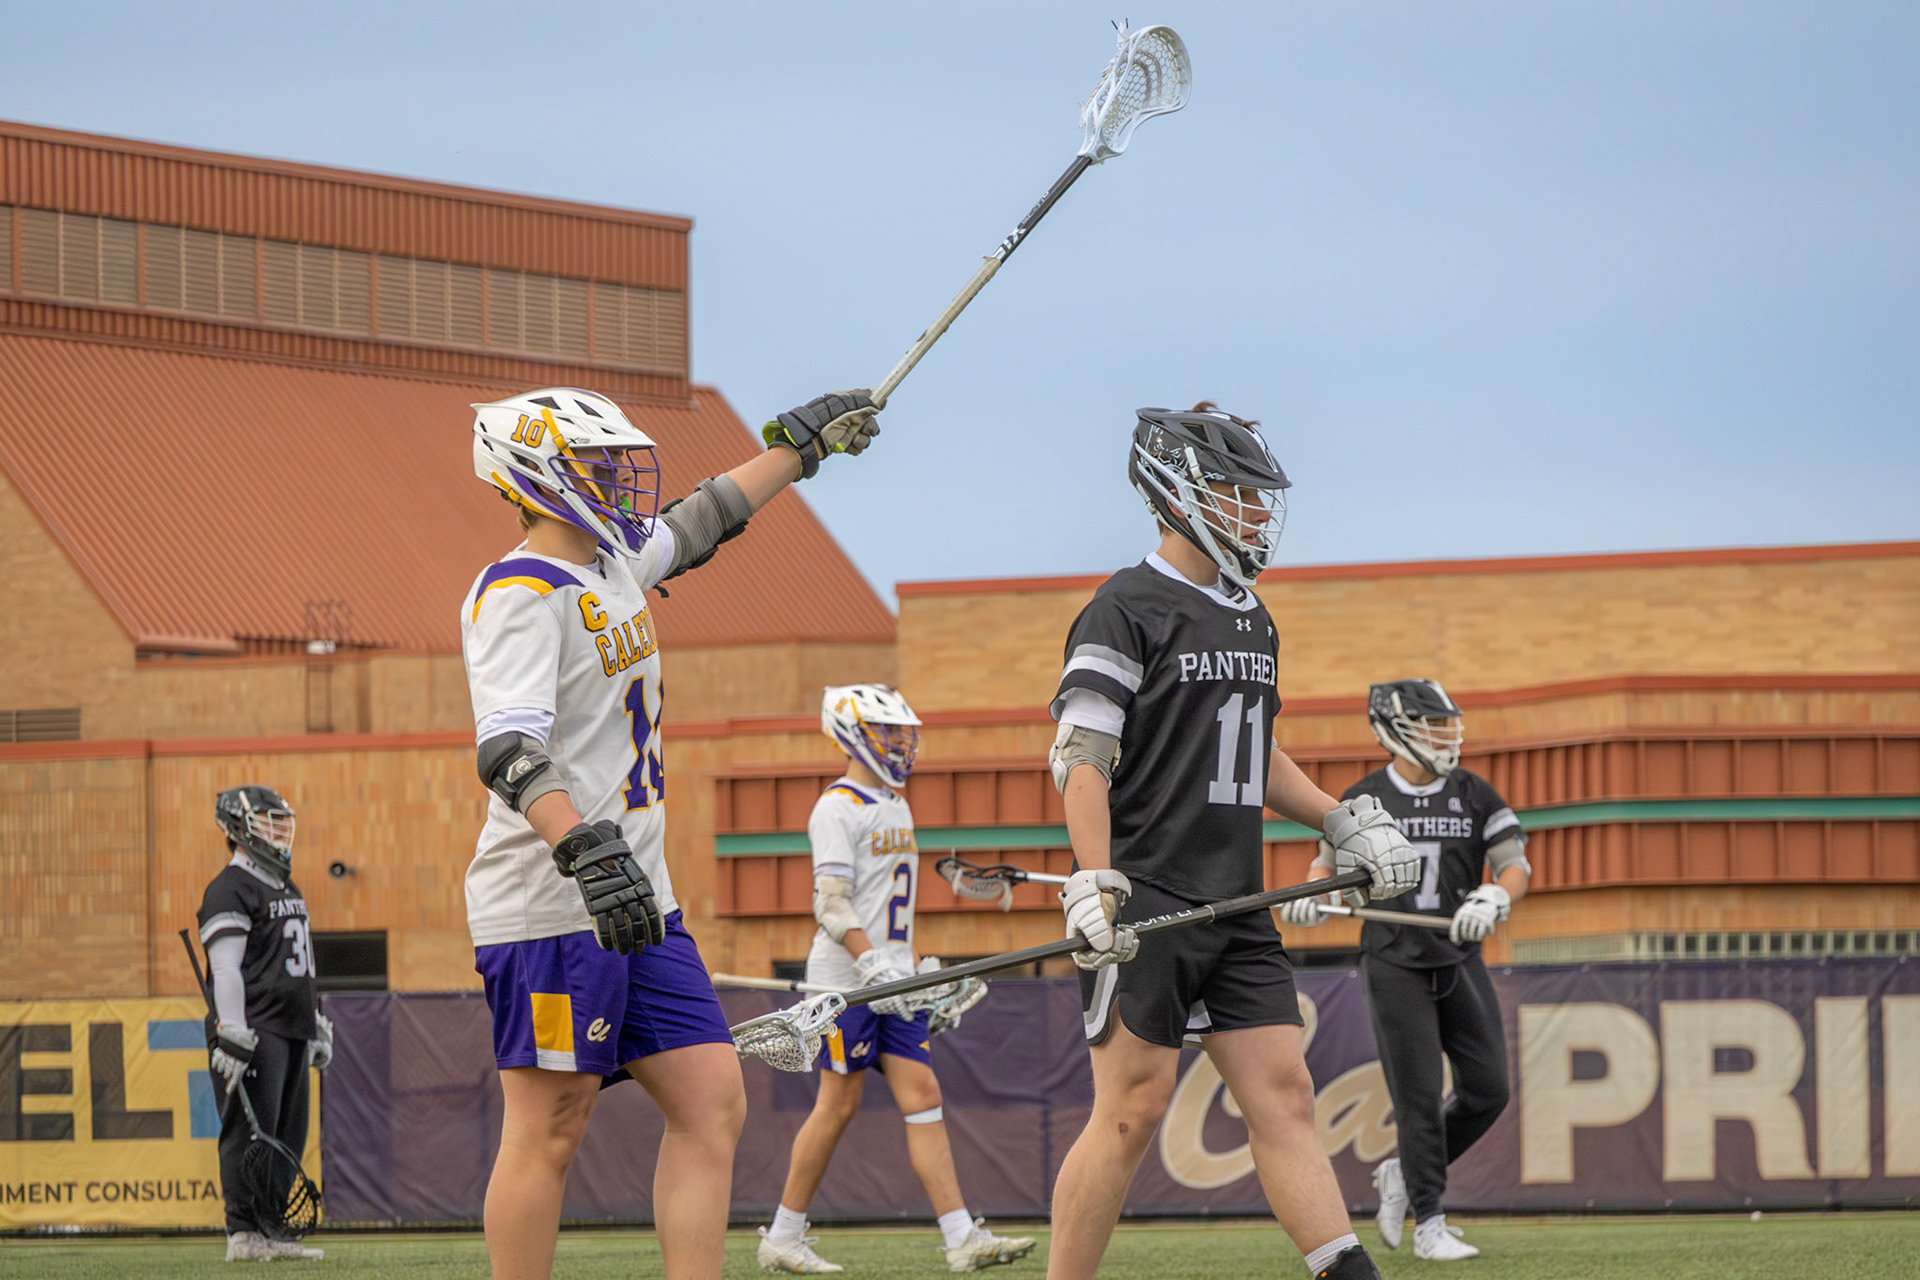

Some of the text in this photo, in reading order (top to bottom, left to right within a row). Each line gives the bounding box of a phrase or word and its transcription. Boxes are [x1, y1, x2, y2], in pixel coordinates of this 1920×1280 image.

[510, 413, 547, 449] 10
[578, 591, 608, 632] C
[1208, 693, 1264, 807] 11
[887, 861, 912, 943] 2
[1518, 994, 1920, 1184] PRI
[0, 1182, 77, 1205] MENT
